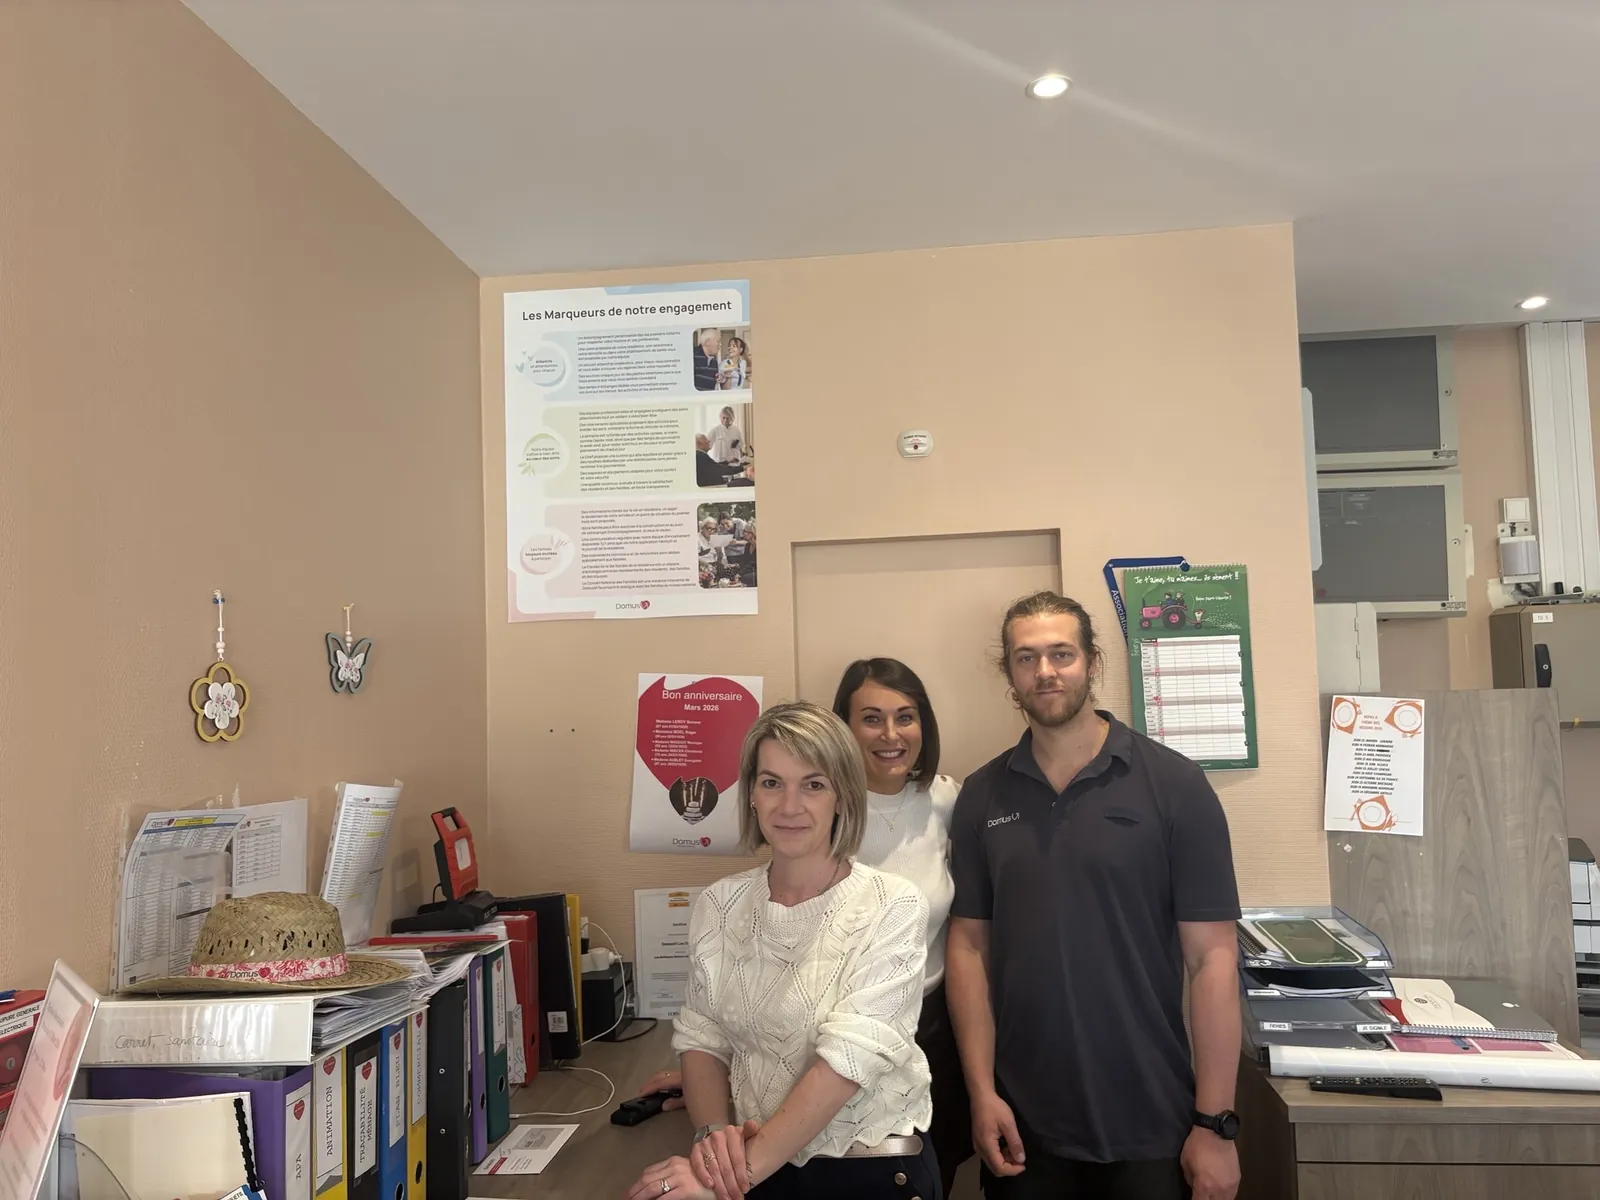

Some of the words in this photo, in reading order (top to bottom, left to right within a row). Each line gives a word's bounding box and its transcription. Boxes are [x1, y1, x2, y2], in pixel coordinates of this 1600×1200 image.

[522, 311, 542, 321] Les
[544, 309, 606, 321] Marqueurs
[608, 307, 622, 316] de
[625, 305, 657, 315] notre
[659, 300, 732, 315] engagement
[662, 690, 681, 699] Bon
[684, 690, 743, 701] anniversaire
[702, 704, 719, 712] 2026
[672, 837, 700, 846] Domus
[230, 971, 259, 979] Domus
[325, 1086, 333, 1156] ANIMATION
